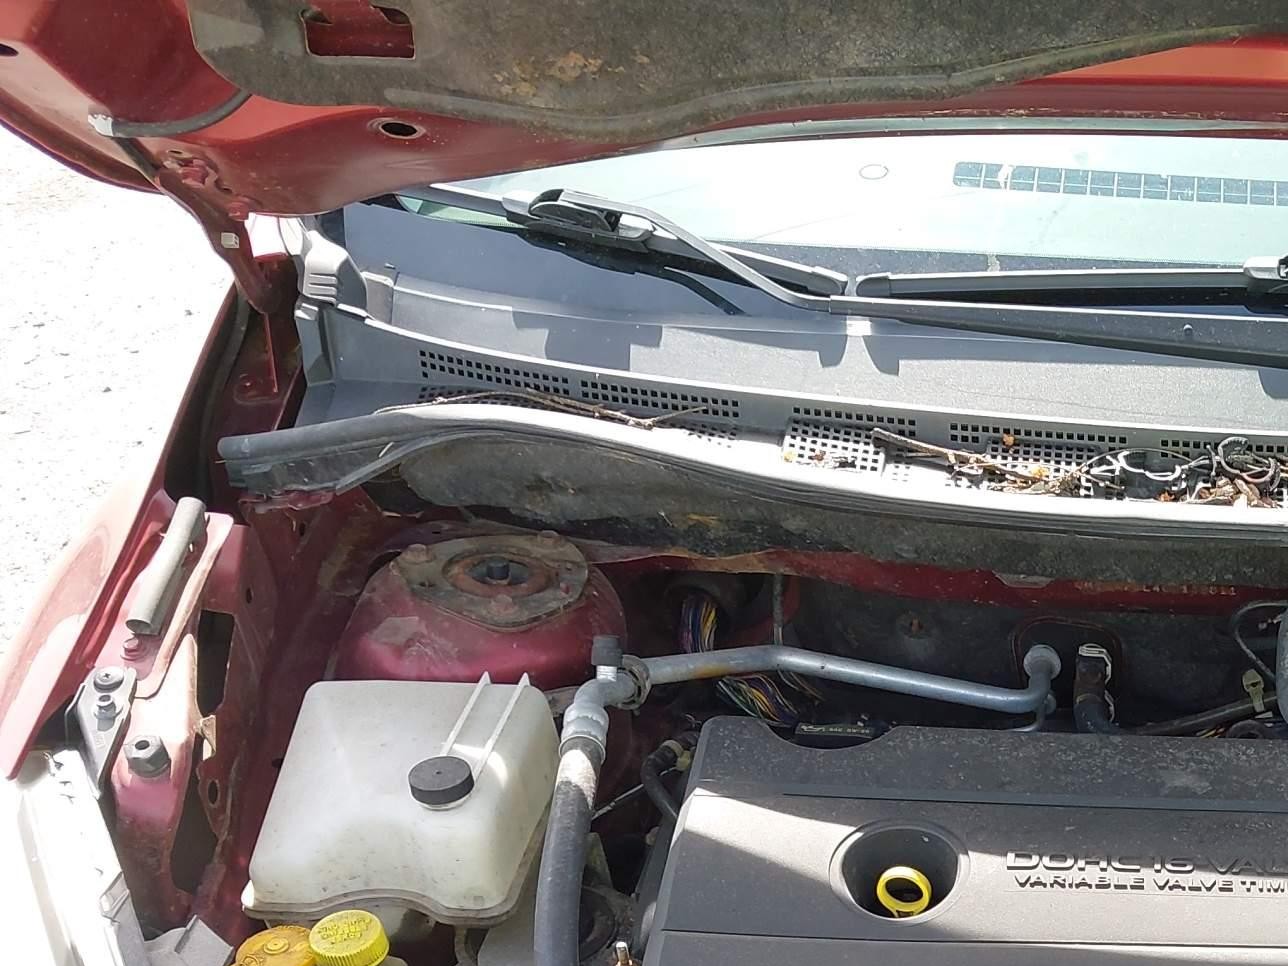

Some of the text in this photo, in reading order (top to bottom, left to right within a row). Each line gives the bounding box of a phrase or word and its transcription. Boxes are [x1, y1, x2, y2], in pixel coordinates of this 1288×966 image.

[1006, 851, 1141, 872] DOHC
[1153, 854, 1195, 874] 16
[1014, 874, 1145, 890] VARIABLE
[1153, 877, 1234, 892] VALVE
